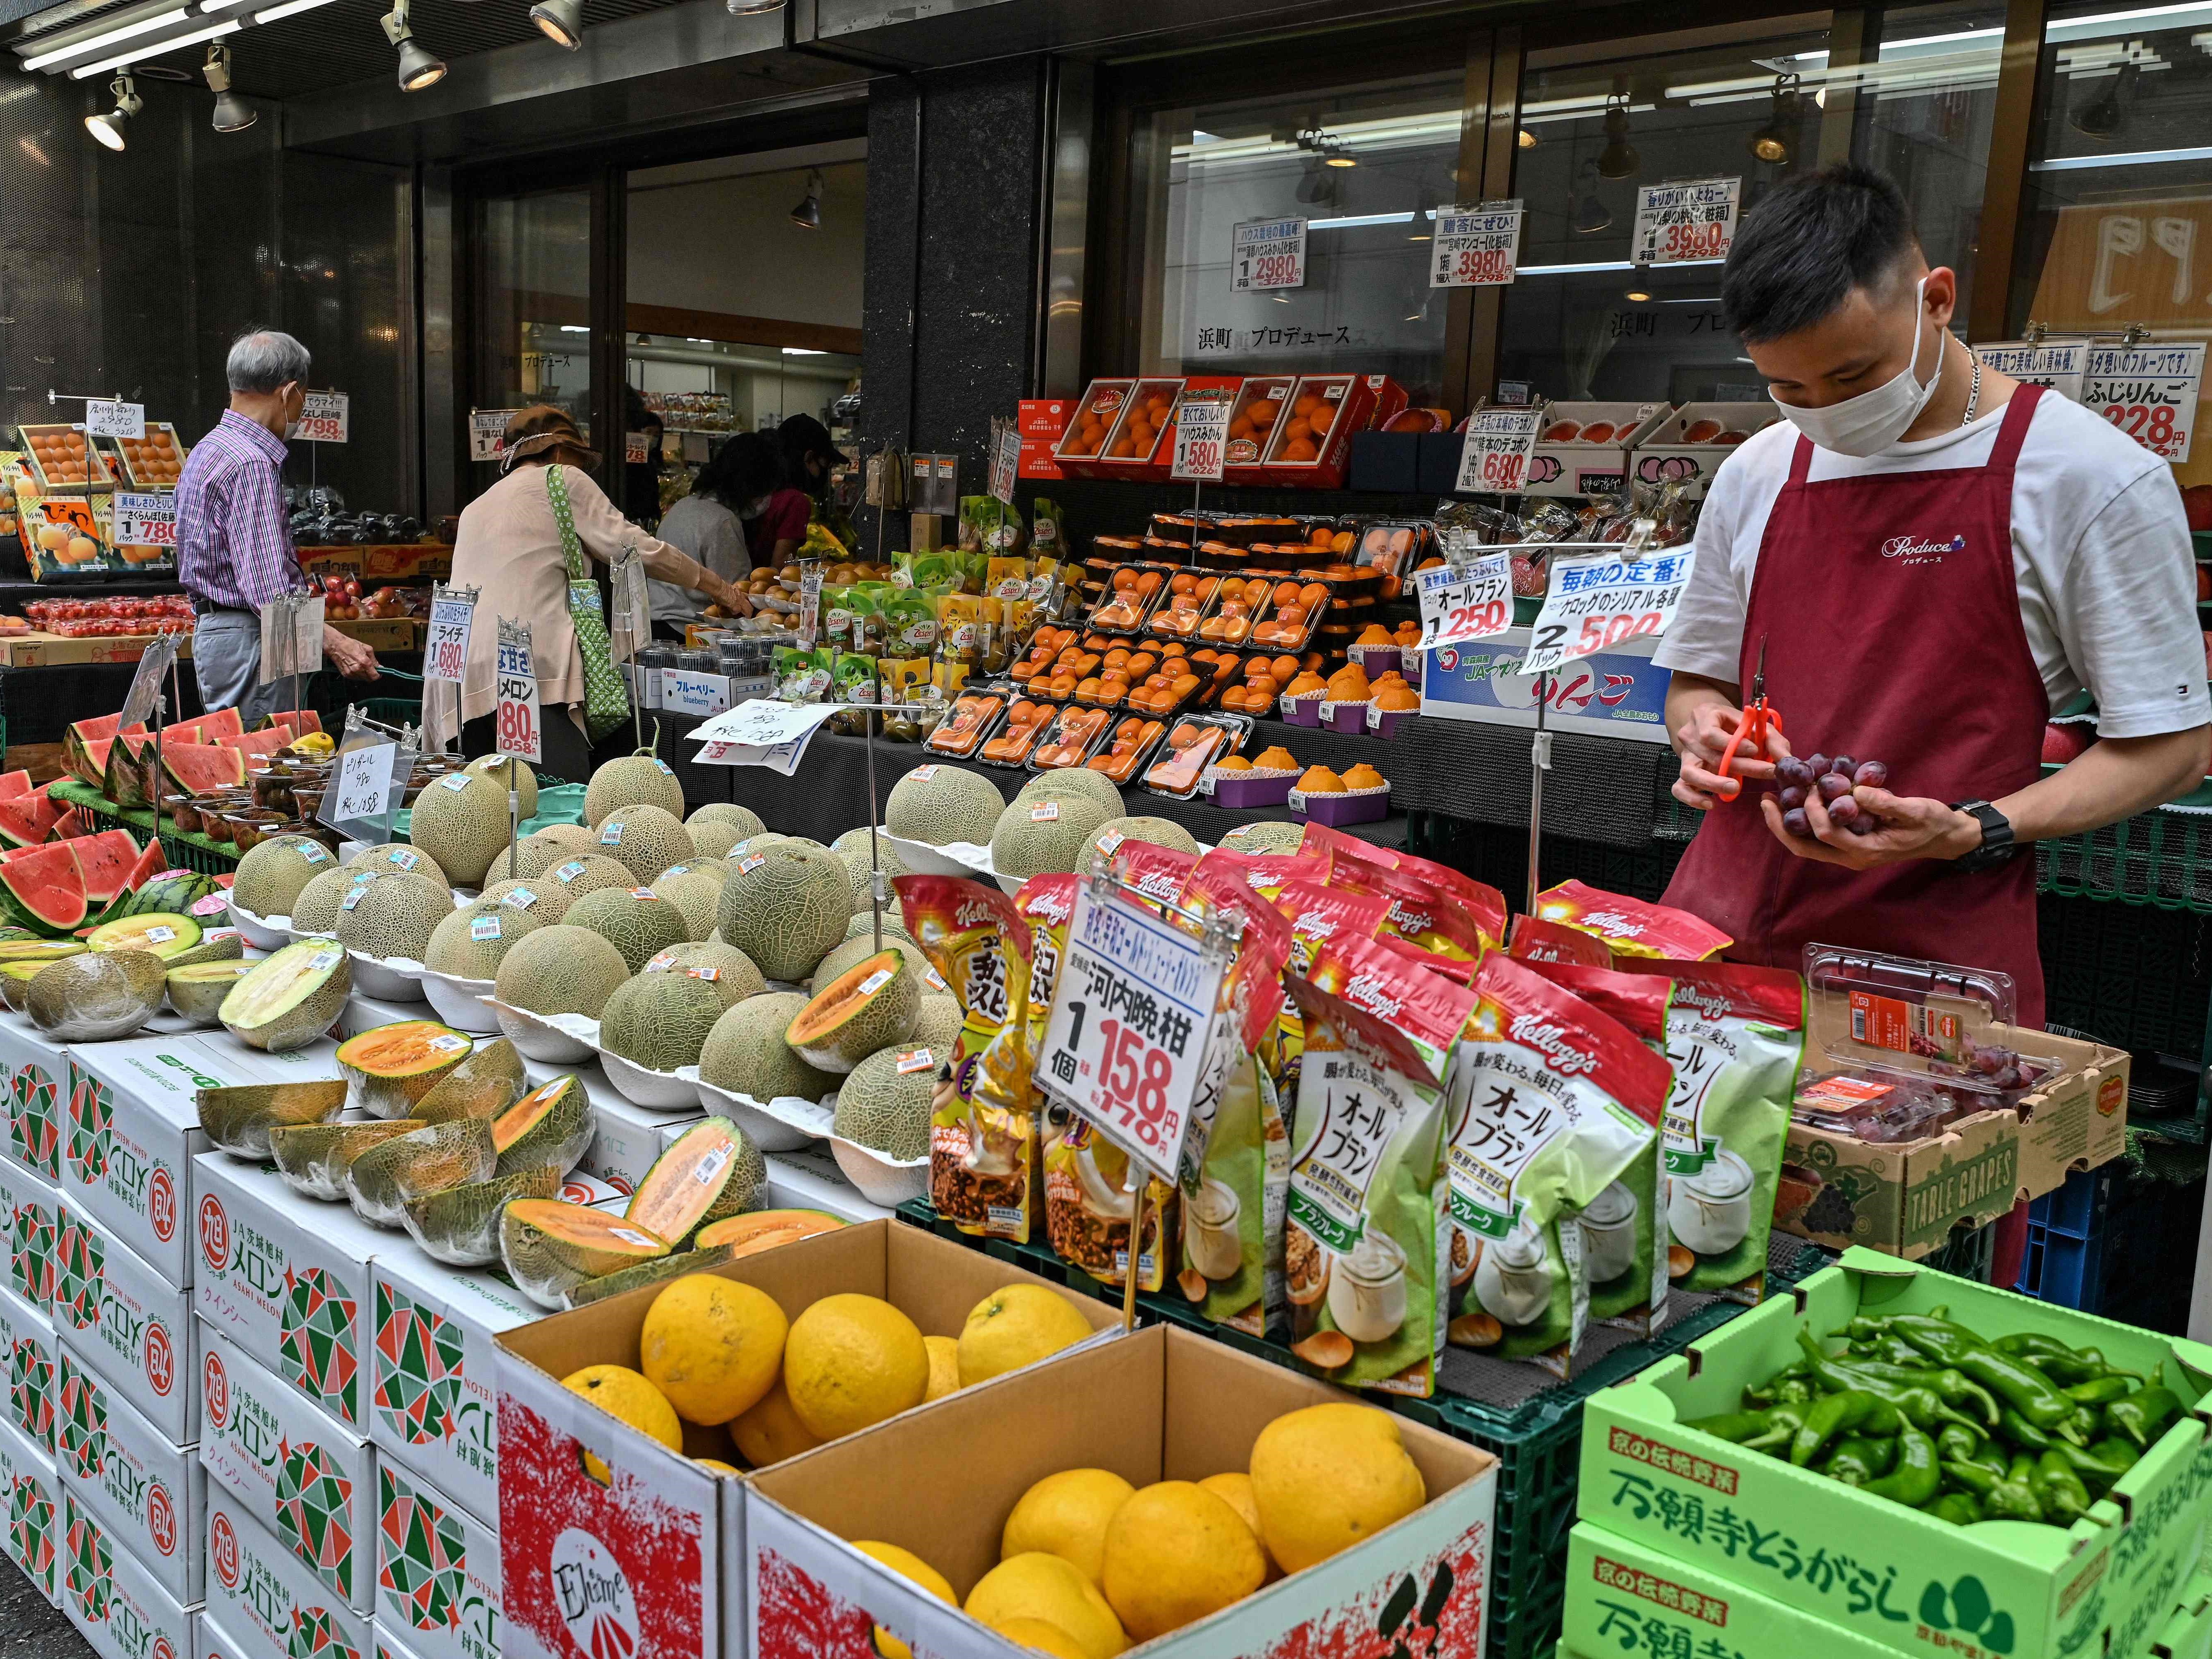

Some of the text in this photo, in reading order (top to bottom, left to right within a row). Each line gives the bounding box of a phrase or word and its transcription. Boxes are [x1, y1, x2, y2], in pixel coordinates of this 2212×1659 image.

[1443, 216, 1513, 233] 贈答にぜひ!
[1448, 233, 1512, 251] 宮崎マンゴー【化粧箱】
[1639, 250, 1656, 261] 箱
[1240, 260, 1249, 277] 1
[1440, 254, 1450, 271] 1箱
[1237, 278, 1249, 287] 箱
[1436, 274, 1450, 283] 1個入
[1198, 325, 1350, 350] 浜町 プロデュース
[1611, 311, 1658, 338] 浜町
[525, 356, 570, 369] プロデュース
[2086, 382, 2186, 404] ふじりんご
[99, 416, 132, 425] 2980
[1183, 407, 1225, 422] 甘くておいしい!
[477, 440, 485, 451] 1
[1185, 426, 1222, 440] ハウスみかん
[1477, 436, 1530, 453] 熊本のデコポン
[1175, 463, 1184, 472] パック
[1180, 443, 1185, 461] 1
[1462, 475, 1475, 486] 2個入
[39, 505, 89, 528] びわ
[122, 521, 131, 533] 1
[1882, 536, 1950, 557] Produce
[1902, 557, 1942, 566] プロデュース
[1562, 558, 1684, 592] 毎朝の定番!
[1439, 578, 1507, 611] オールブラン
[1559, 585, 1682, 618] ケロッグのシリアル各種
[439, 626, 463, 642] ライチ
[914, 629, 933, 637] Zespri
[1424, 633, 1439, 645] 袋
[1428, 617, 1440, 634] 1
[1535, 625, 1568, 649] 2
[432, 642, 437, 661] 1
[1462, 654, 1490, 665] 青森県産
[1527, 649, 1561, 668] パック
[683, 696, 709, 707] blueberry
[1529, 673, 1634, 709] りんご
[1613, 709, 1659, 720] JA全農あおもり
[356, 773, 370, 787] 980
[1026, 893, 1070, 926] Kellogg's
[1293, 910, 1340, 940] Kellogg's
[1581, 912, 1645, 938] Kellogg's
[1084, 961, 1192, 1059] 河内晩柑
[1345, 973, 1403, 1020] Kellogg's
[1069, 1002, 1086, 1052] 1
[1509, 1014, 1596, 1073] Kellogg's
[1052, 1048, 1077, 1085] 個
[1339, 1093, 1385, 1140] オール
[1483, 1085, 1551, 1137] オール
[112, 1128, 147, 1160] ASAHI MELON
[1323, 1130, 1374, 1175] ブラン
[1468, 1118, 1526, 1166] ブラン
[109, 1145, 150, 1196] メロン
[1911, 1154, 2012, 1233] TABLE GRAPES
[205, 1205, 224, 1255] 旭
[230, 1241, 283, 1299] メロン
[104, 1278, 141, 1313] ASAHI MELON
[233, 1279, 280, 1319] ASAHI MELON
[101, 1296, 143, 1348] メロン
[209, 1365, 225, 1415] 旭
[228, 1403, 277, 1467] メロン
[107, 1433, 143, 1472] ASAHI MELON
[230, 1440, 275, 1487] ASAHI MELON
[1613, 1431, 1736, 1494] 京の伝統野菜
[105, 1451, 146, 1504] メロン
[217, 1525, 234, 1576] 旭
[1610, 1469, 1910, 1622] 万願寺とうがらし
[113, 1580, 149, 1624] ASAHI MELON
[240, 1567, 289, 1633] メロン
[553, 1563, 625, 1623] Ehime
[1598, 1563, 1726, 1626] 京の伝統野菜
[111, 1598, 151, 1655] メロン
[243, 1604, 287, 1655] ASAHI MELON
